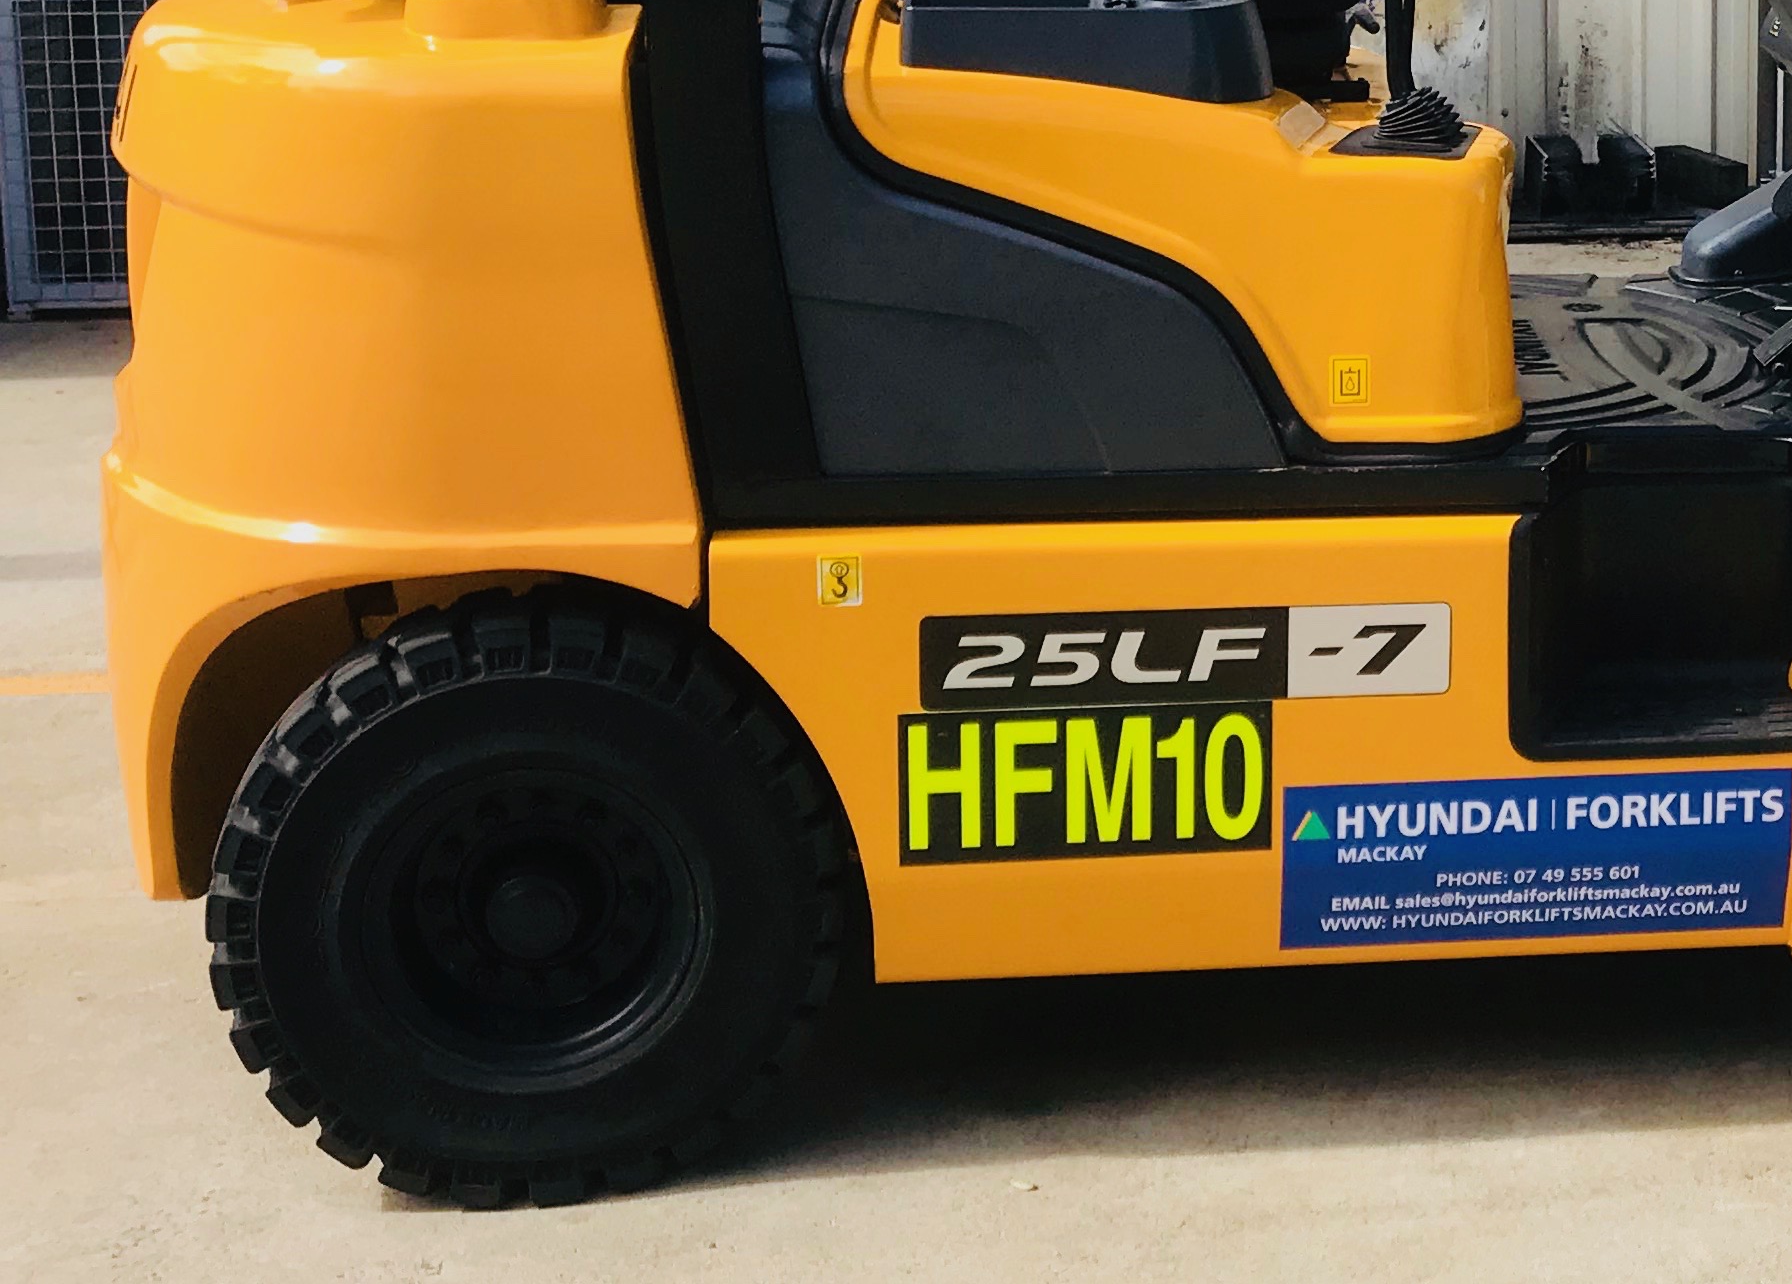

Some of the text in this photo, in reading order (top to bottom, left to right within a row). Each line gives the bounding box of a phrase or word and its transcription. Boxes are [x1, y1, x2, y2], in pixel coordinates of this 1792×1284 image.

[942, 623, 1427, 689] 25LF -7
[907, 712, 1264, 850] HFM10
[1336, 788, 1785, 840] HYUNDAI FORKLIFTS
[1336, 844, 1428, 864] MACKAY
[1436, 865, 1640, 887] PHONE: 07 49 555 601
[1331, 882, 1741, 912] EMAIL sales@hyundaiforkliftsmackay.com.au
[1320, 899, 1748, 932] WWW: HYUNDAIFORKLIFTSMACKAY.COM.AU
